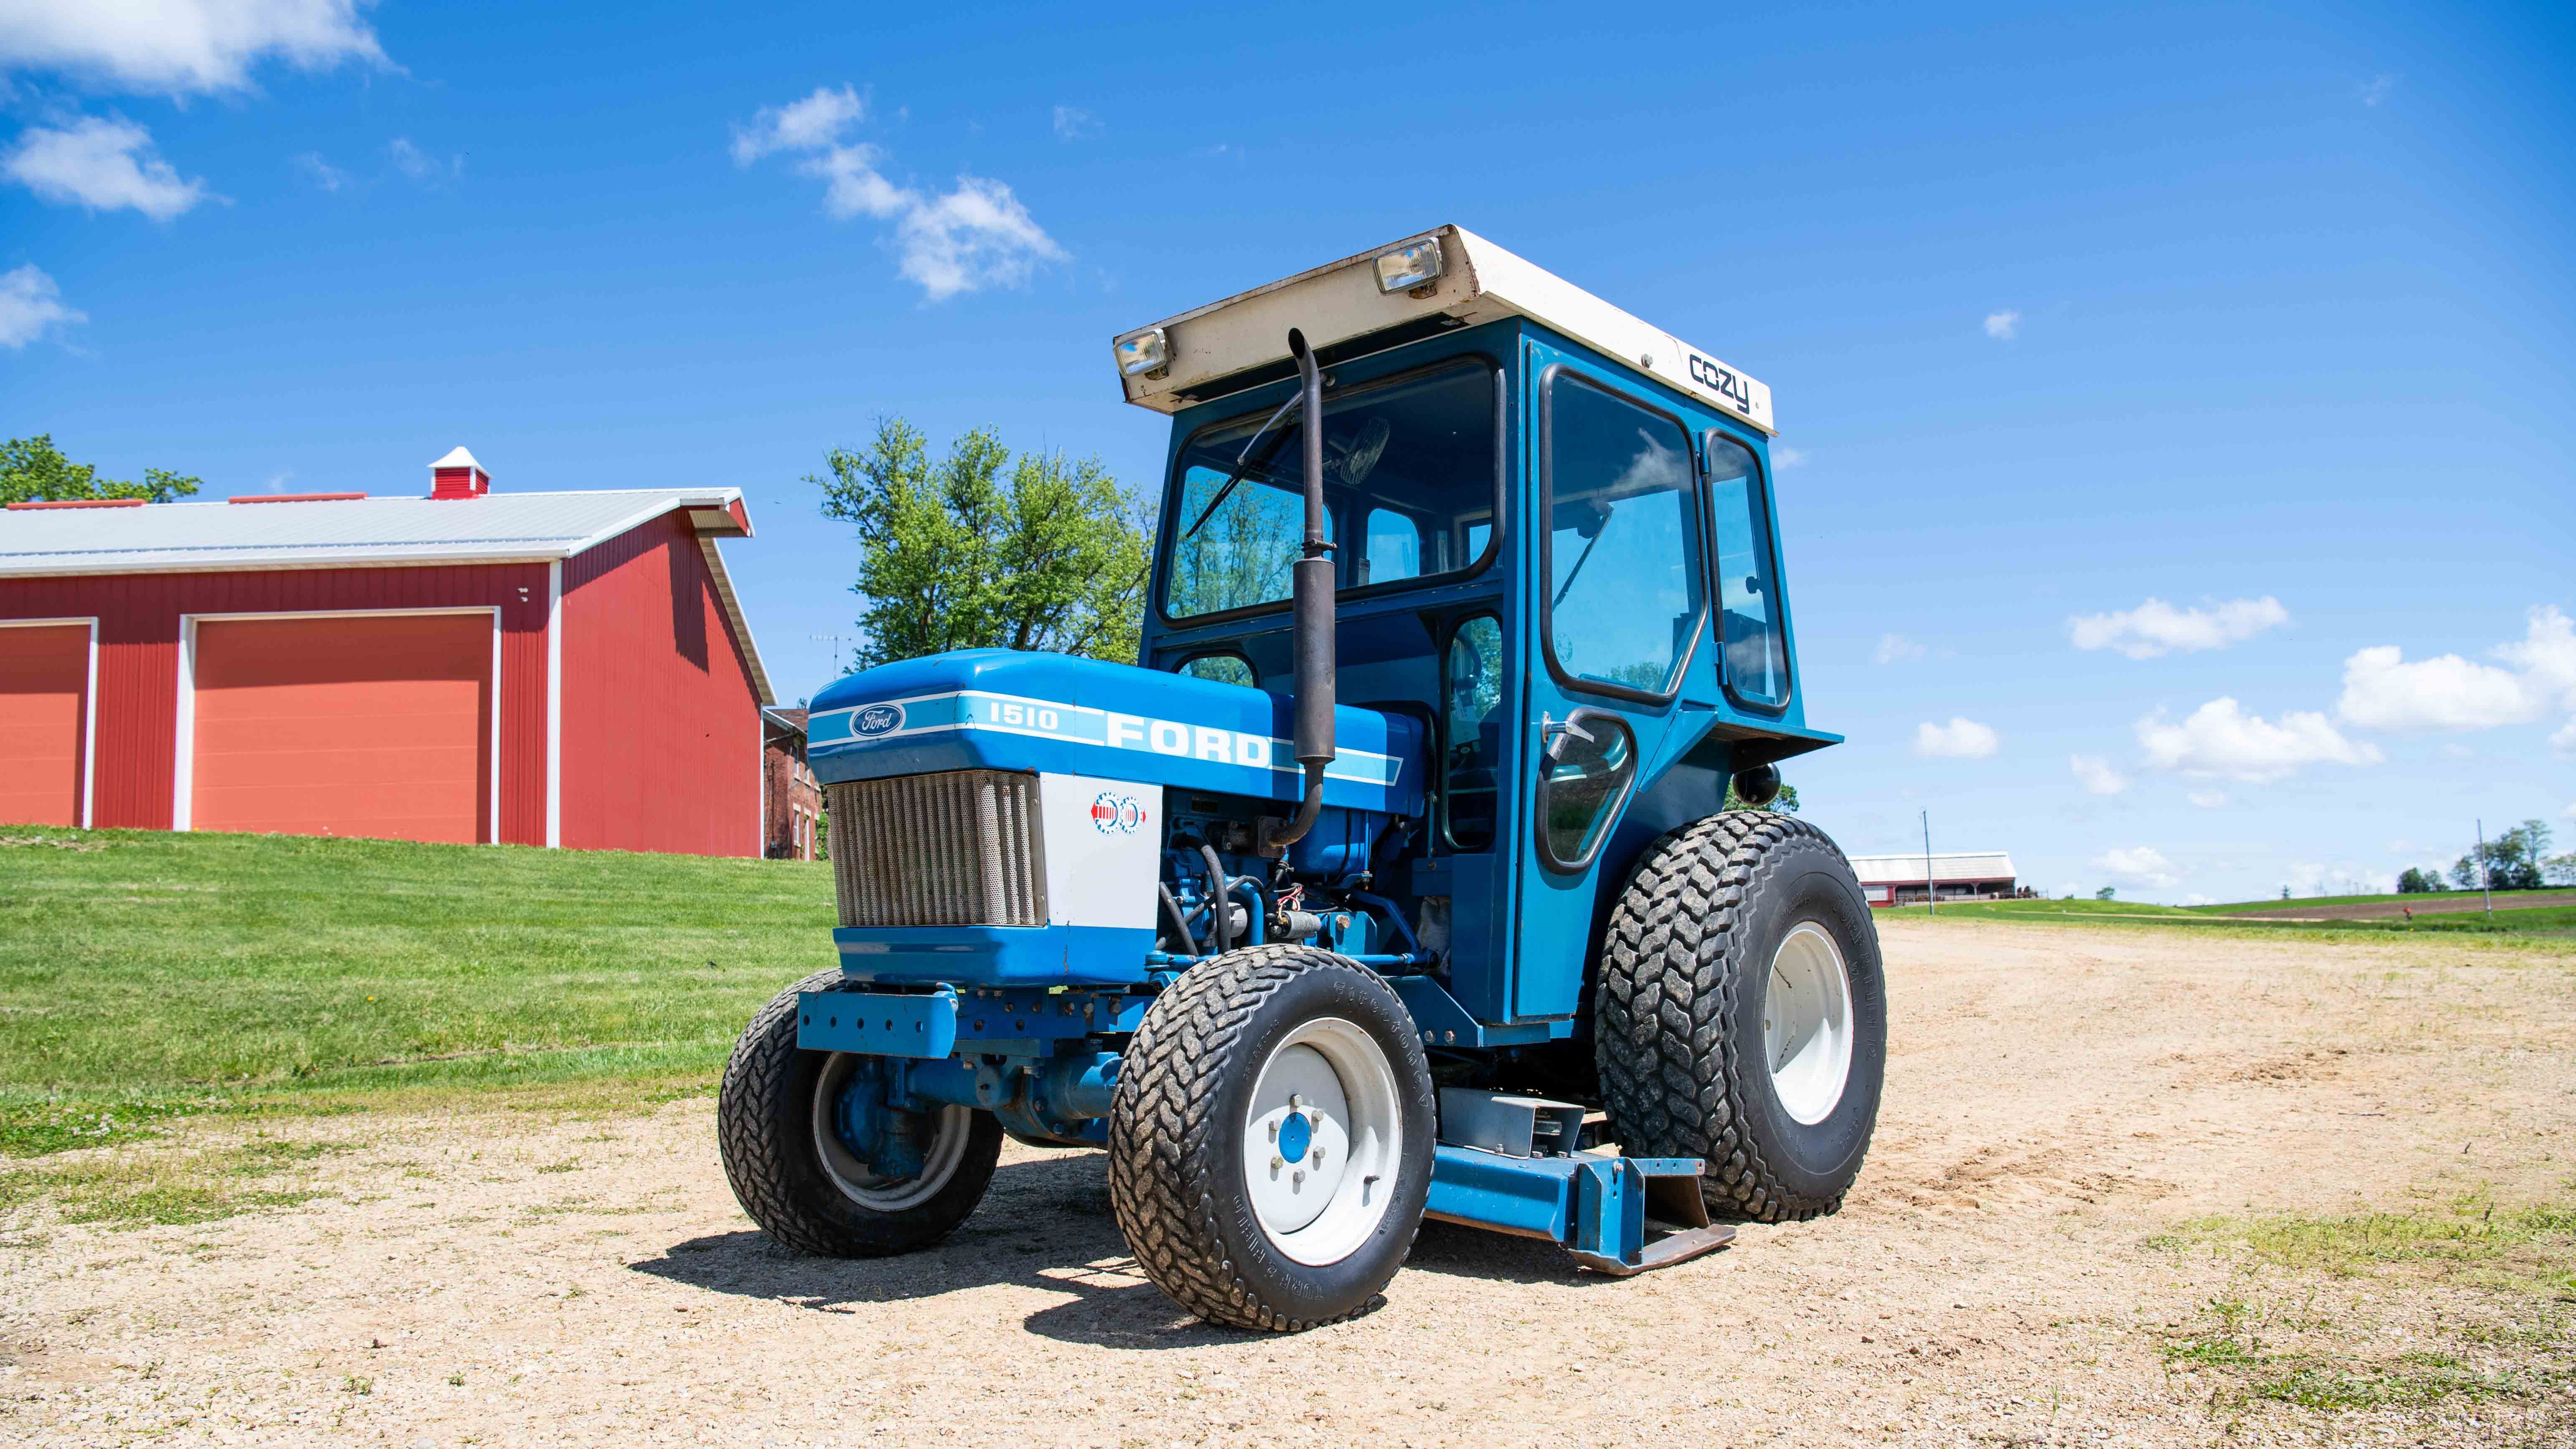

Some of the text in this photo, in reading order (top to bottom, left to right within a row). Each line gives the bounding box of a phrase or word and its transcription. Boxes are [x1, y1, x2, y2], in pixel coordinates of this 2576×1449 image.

[862, 710, 892, 731] Ford
[991, 702, 1058, 730] 1510
[1107, 713, 1270, 768] FORD
[1832, 893, 1865, 946] TURF
[1334, 982, 1423, 1085] Firestone
[1233, 1195, 1324, 1300] TURF & FIELD
